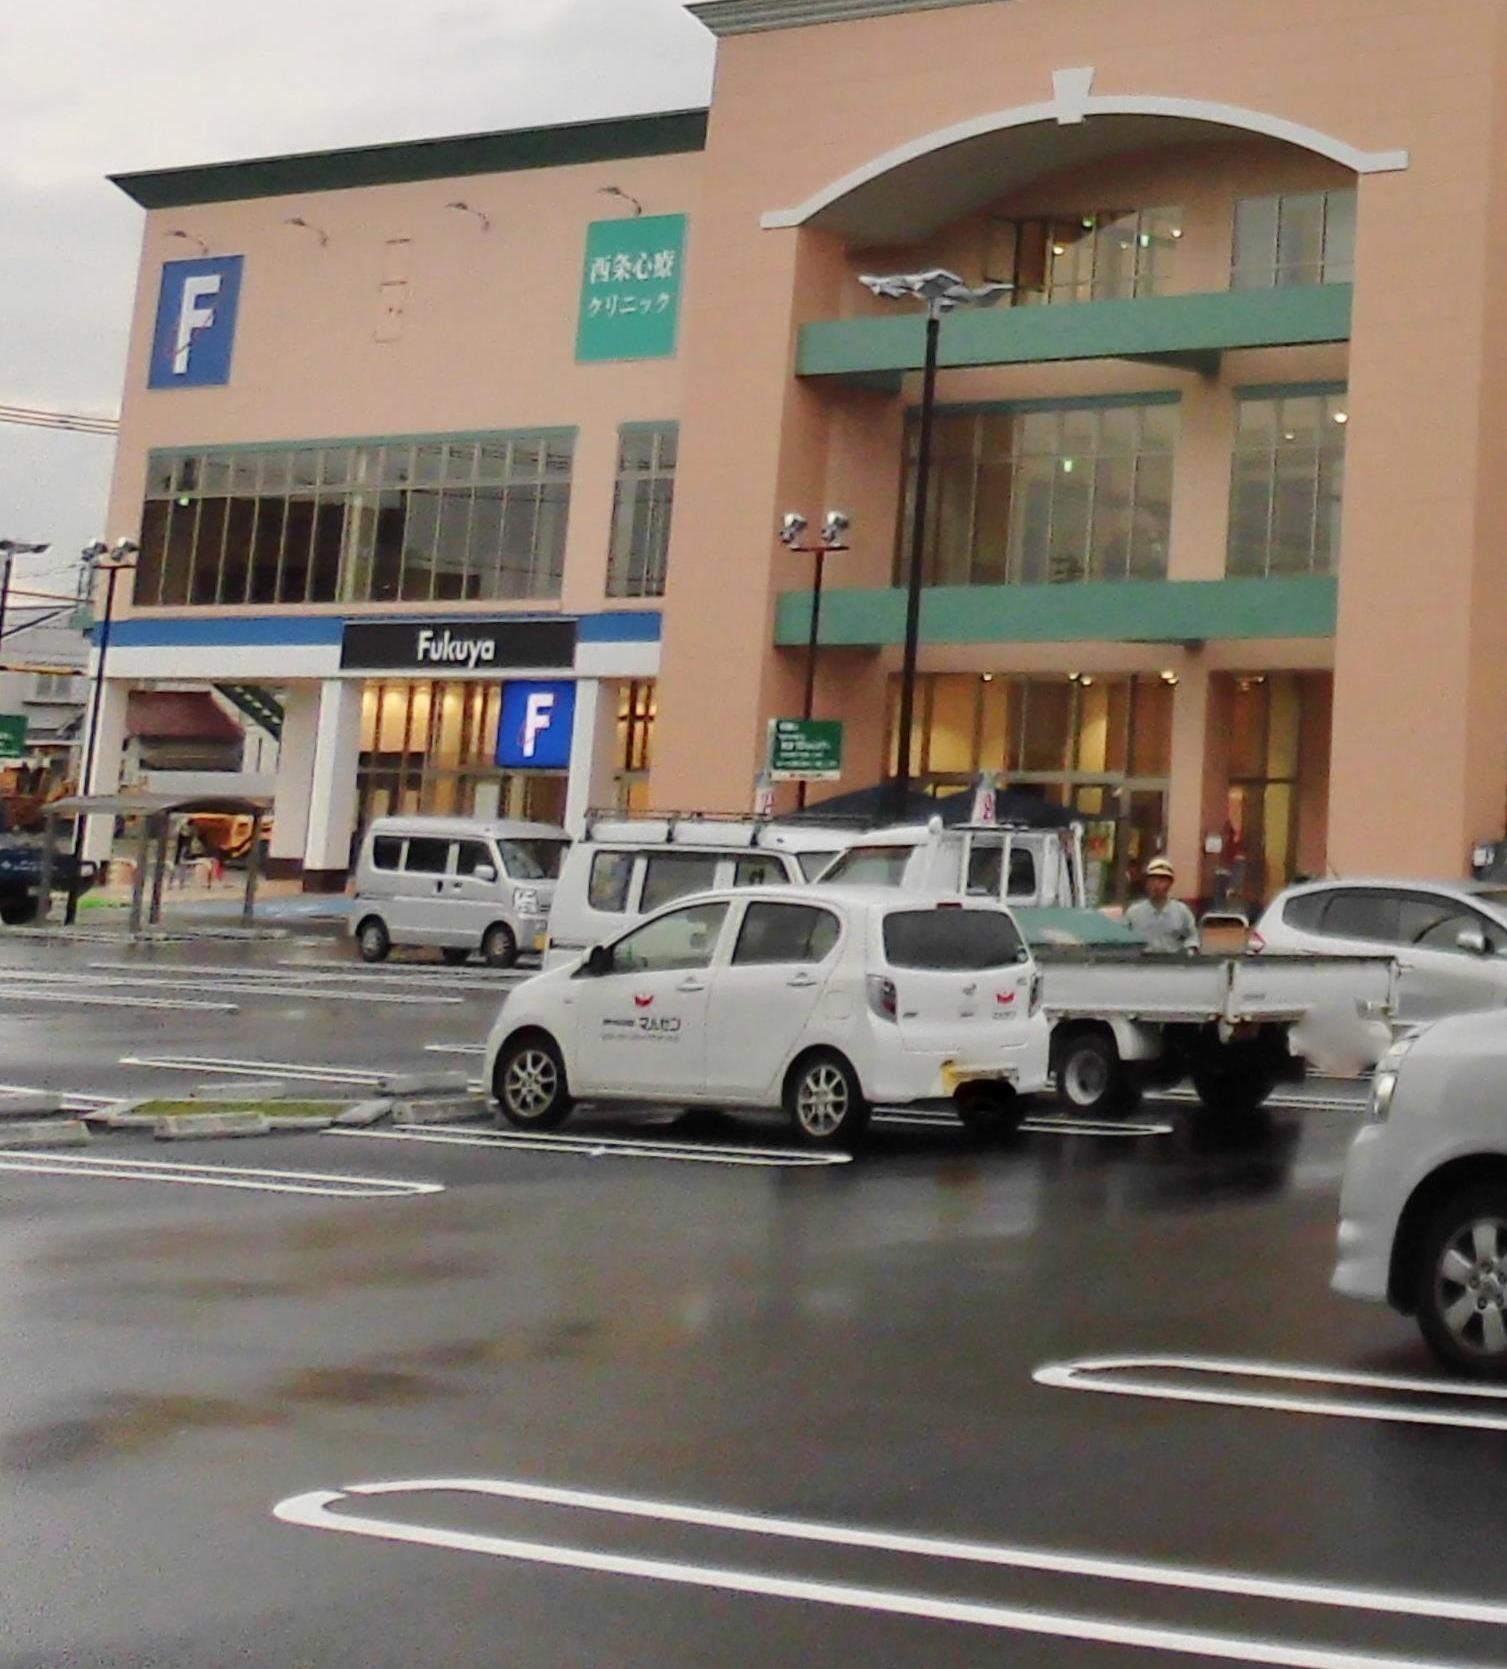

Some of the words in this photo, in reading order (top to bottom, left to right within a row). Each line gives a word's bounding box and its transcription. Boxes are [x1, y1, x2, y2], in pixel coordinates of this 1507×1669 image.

[172, 274, 221, 374] F
[588, 292, 670, 318] クリニック
[416, 630, 496, 668] Fukuya
[522, 692, 555, 758] F
